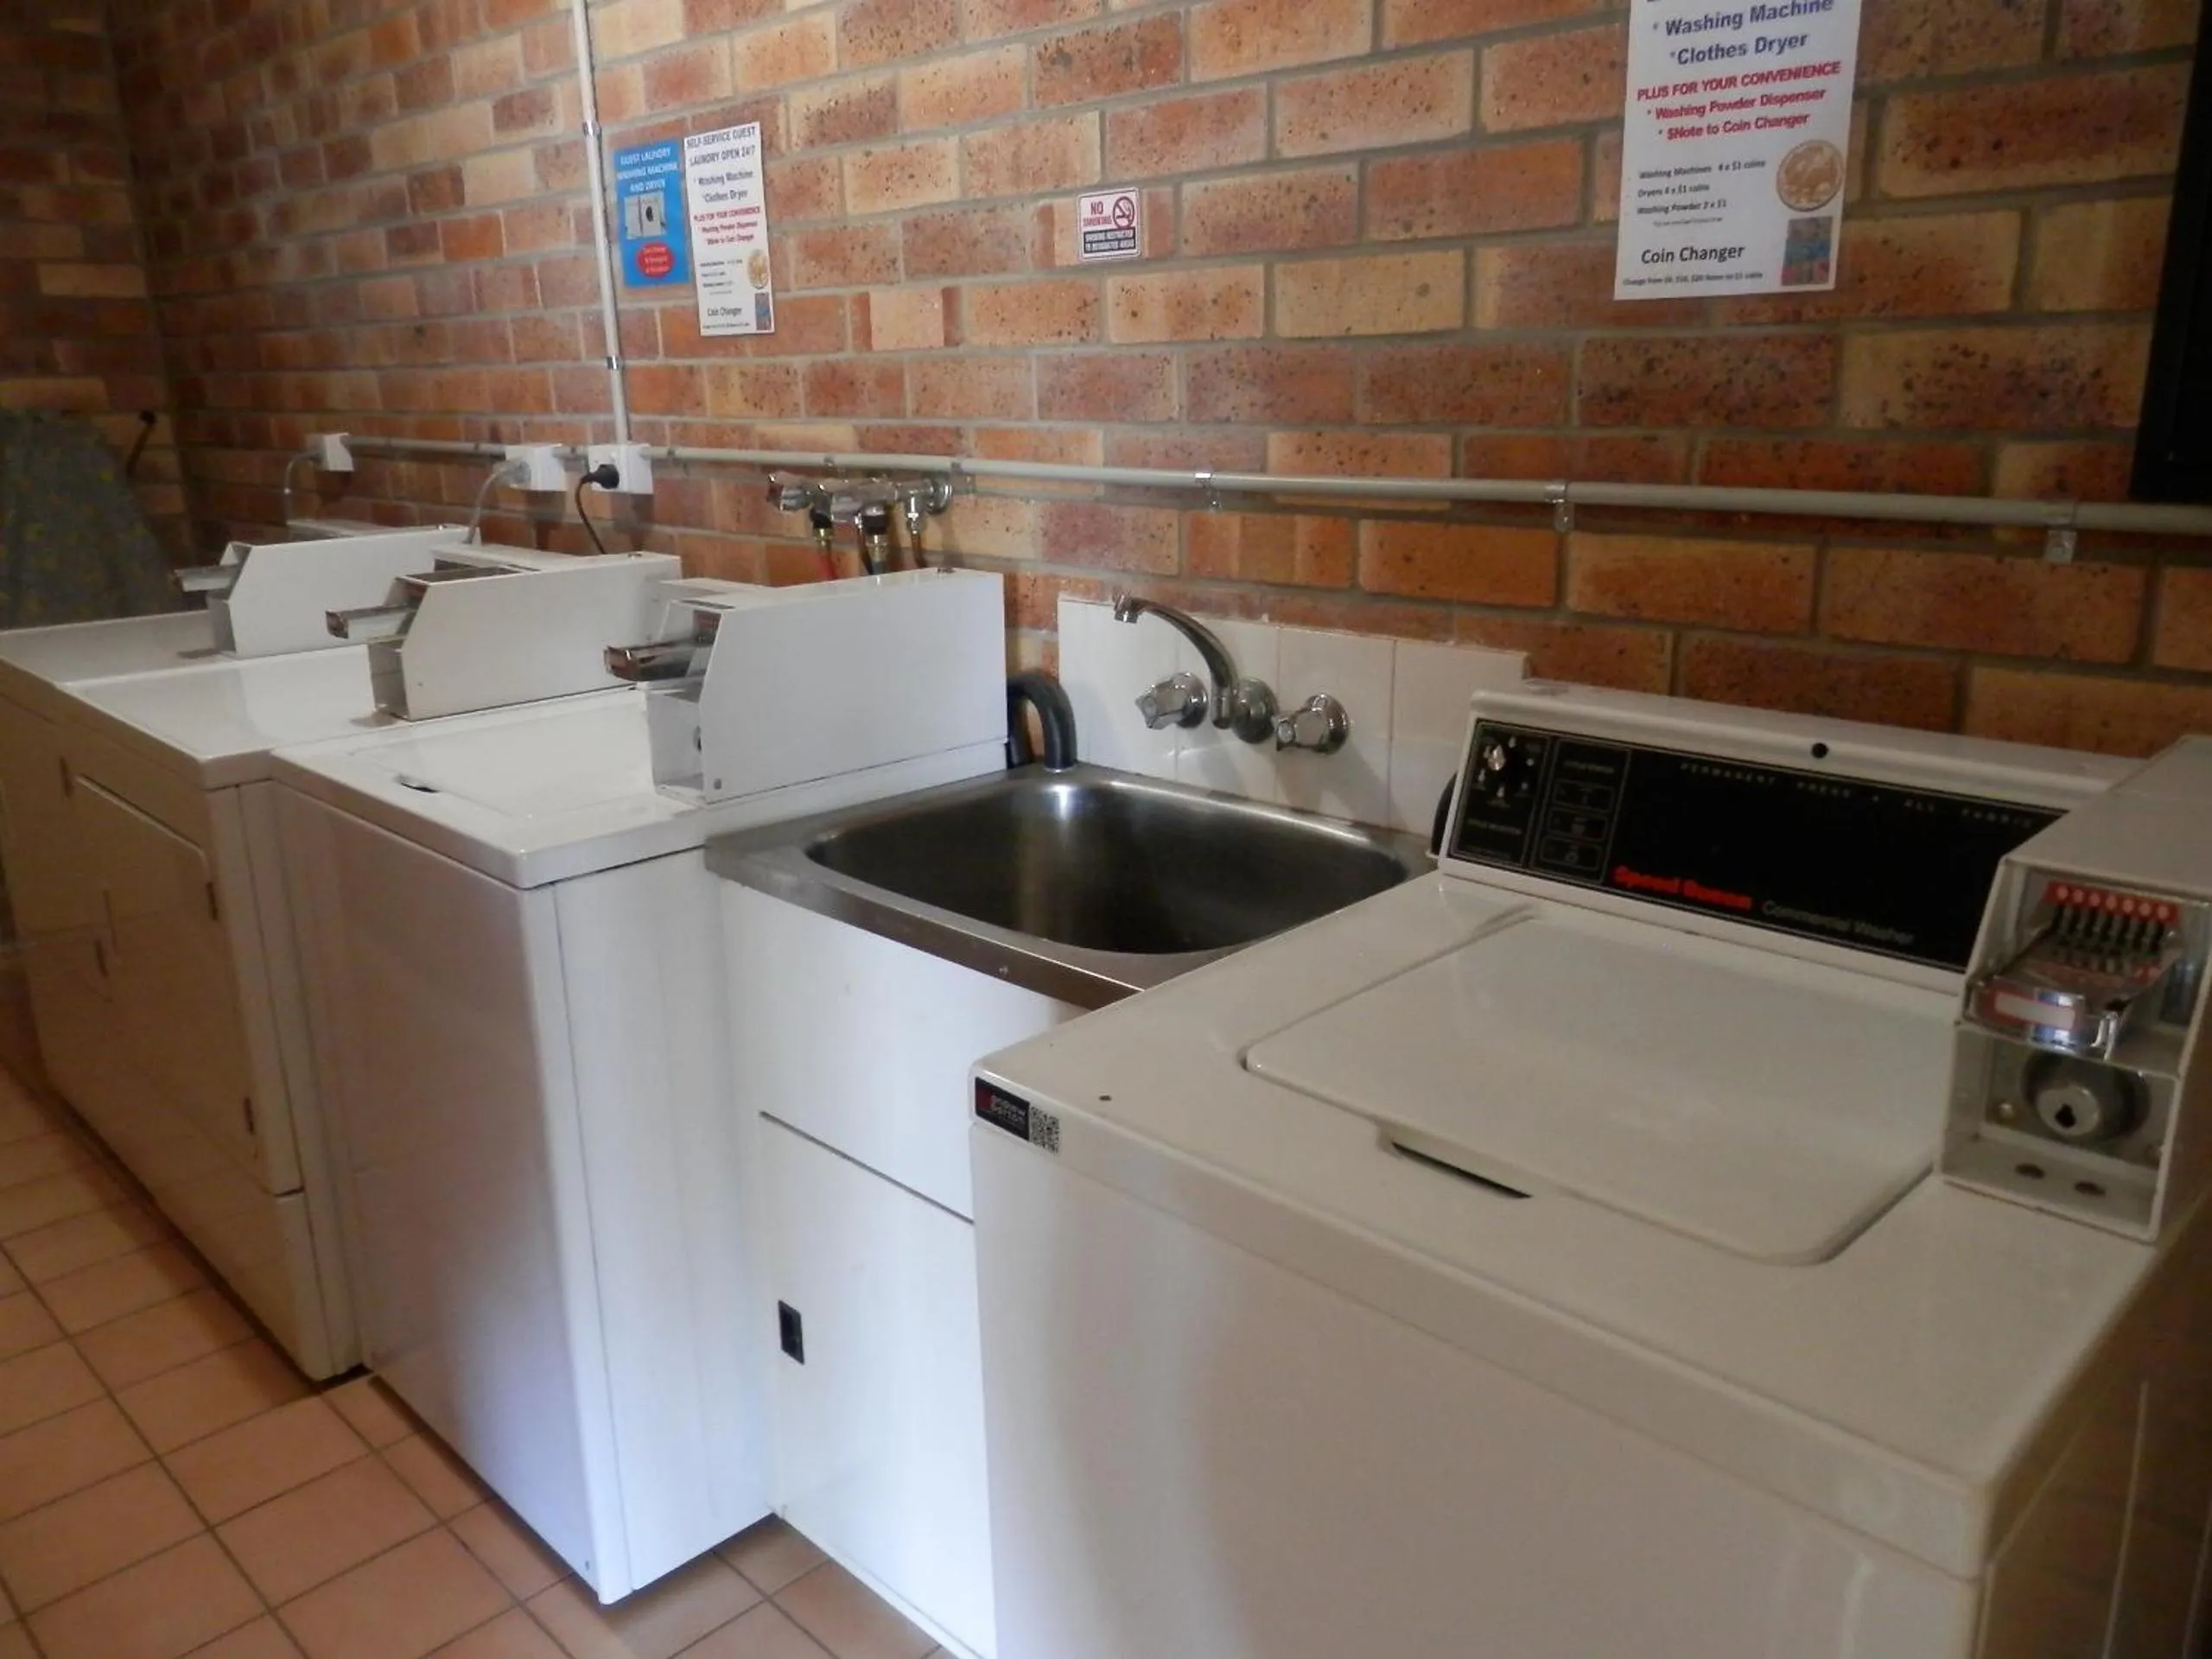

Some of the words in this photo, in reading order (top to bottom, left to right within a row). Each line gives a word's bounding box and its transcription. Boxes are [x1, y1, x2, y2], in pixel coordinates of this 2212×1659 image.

[1665, 11, 1744, 36] Washing
[1749, 0, 1834, 22] Machine
[1755, 34, 1808, 55] Dryer
[1637, 87, 1669, 101] PLUS
[1672, 82, 1699, 96] FOR
[1701, 76, 1738, 92] YOUR
[1741, 61, 1841, 86] CONVENIENCE
[1655, 104, 1706, 120] Washing
[1709, 98, 1756, 112] Powder
[1760, 88, 1827, 107] Dispenser
[1707, 124, 1720, 135] to
[1723, 120, 1751, 133] Coin
[1754, 113, 1810, 130] Changer
[641, 147, 671, 162] LAUNDRY
[721, 148, 740, 161] OPEN
[1090, 201, 1104, 215] NO
[1641, 248, 1675, 264] Coin
[1679, 245, 1746, 263] Changer
